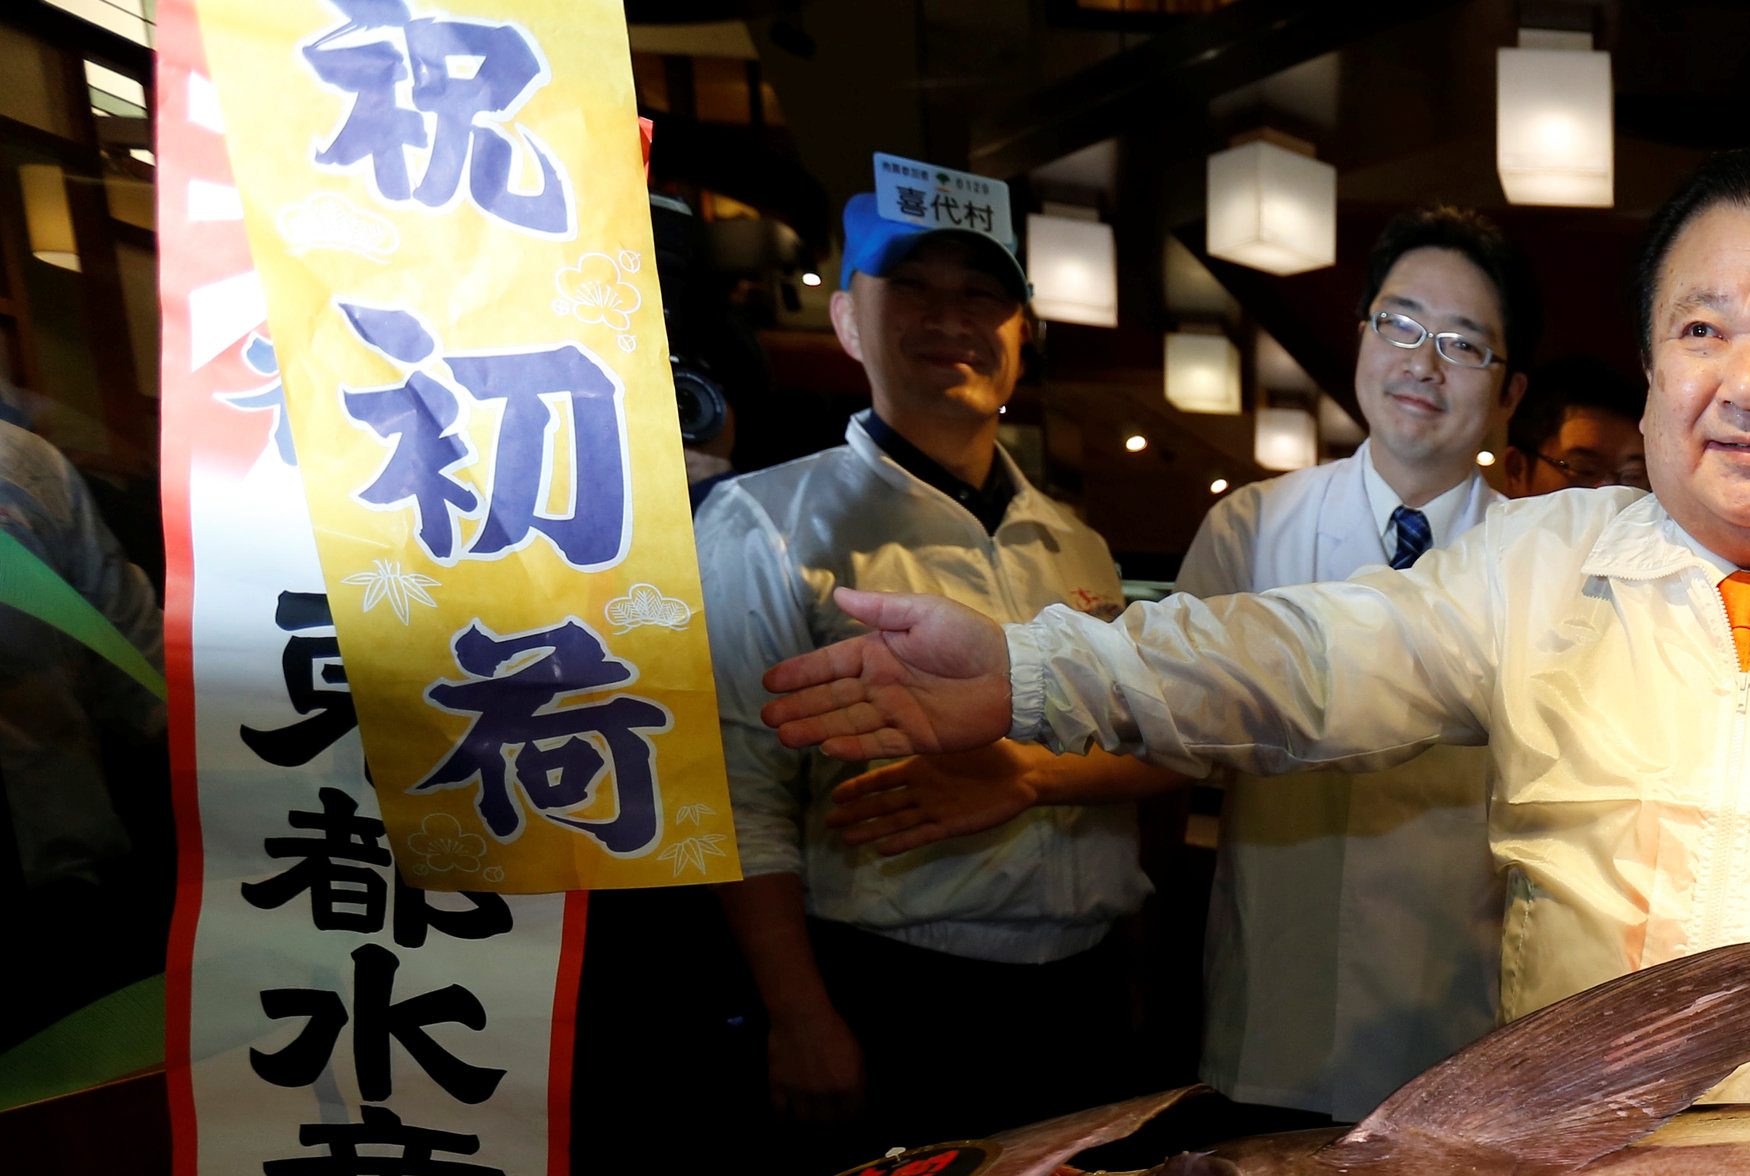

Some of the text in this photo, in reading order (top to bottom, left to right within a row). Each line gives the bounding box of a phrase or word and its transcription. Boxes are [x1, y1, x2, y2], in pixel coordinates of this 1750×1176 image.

[300, 0, 672, 855] 祝初荷
[896, 185, 994, 233] 喜代村
